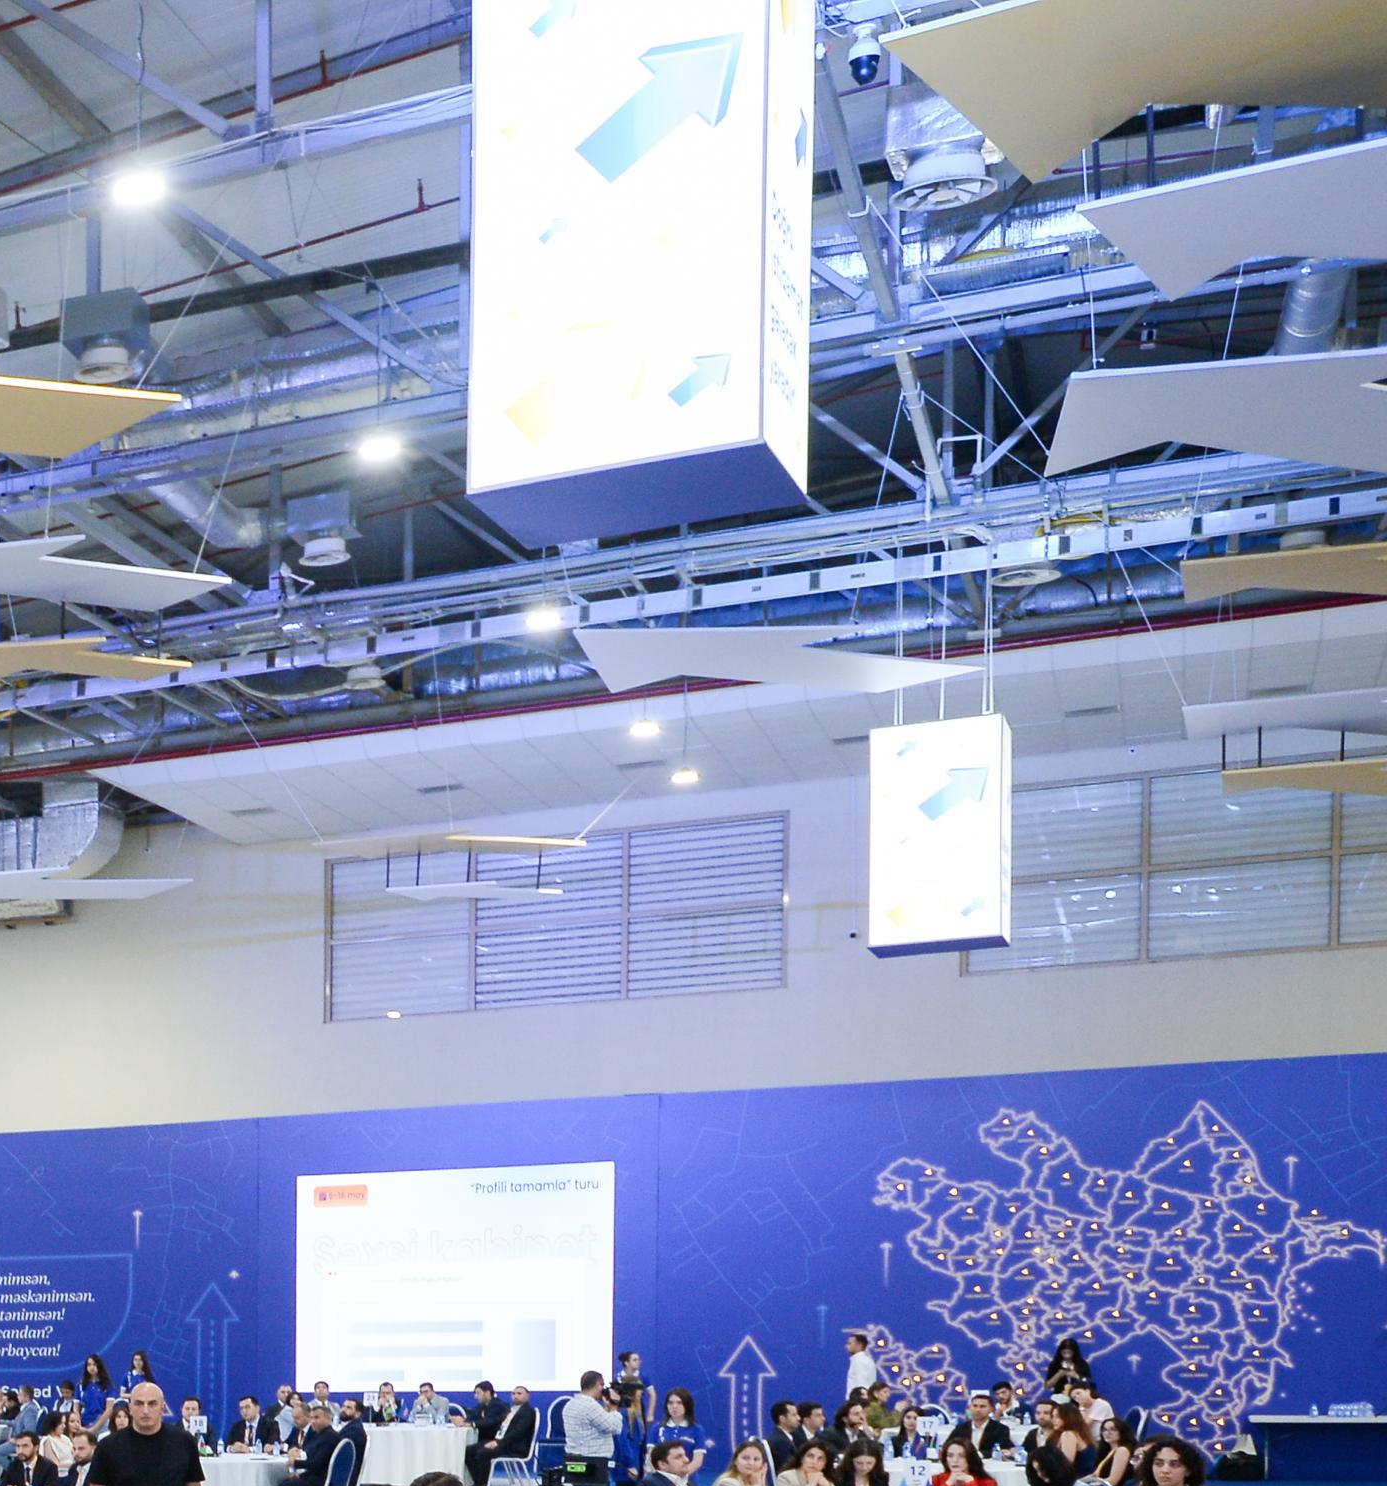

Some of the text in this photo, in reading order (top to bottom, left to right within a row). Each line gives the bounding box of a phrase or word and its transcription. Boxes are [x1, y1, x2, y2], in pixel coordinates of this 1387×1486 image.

[575, 1179, 599, 1190] turu
[922, 1421, 933, 1429] 17
[911, 1466, 926, 1476] 12
